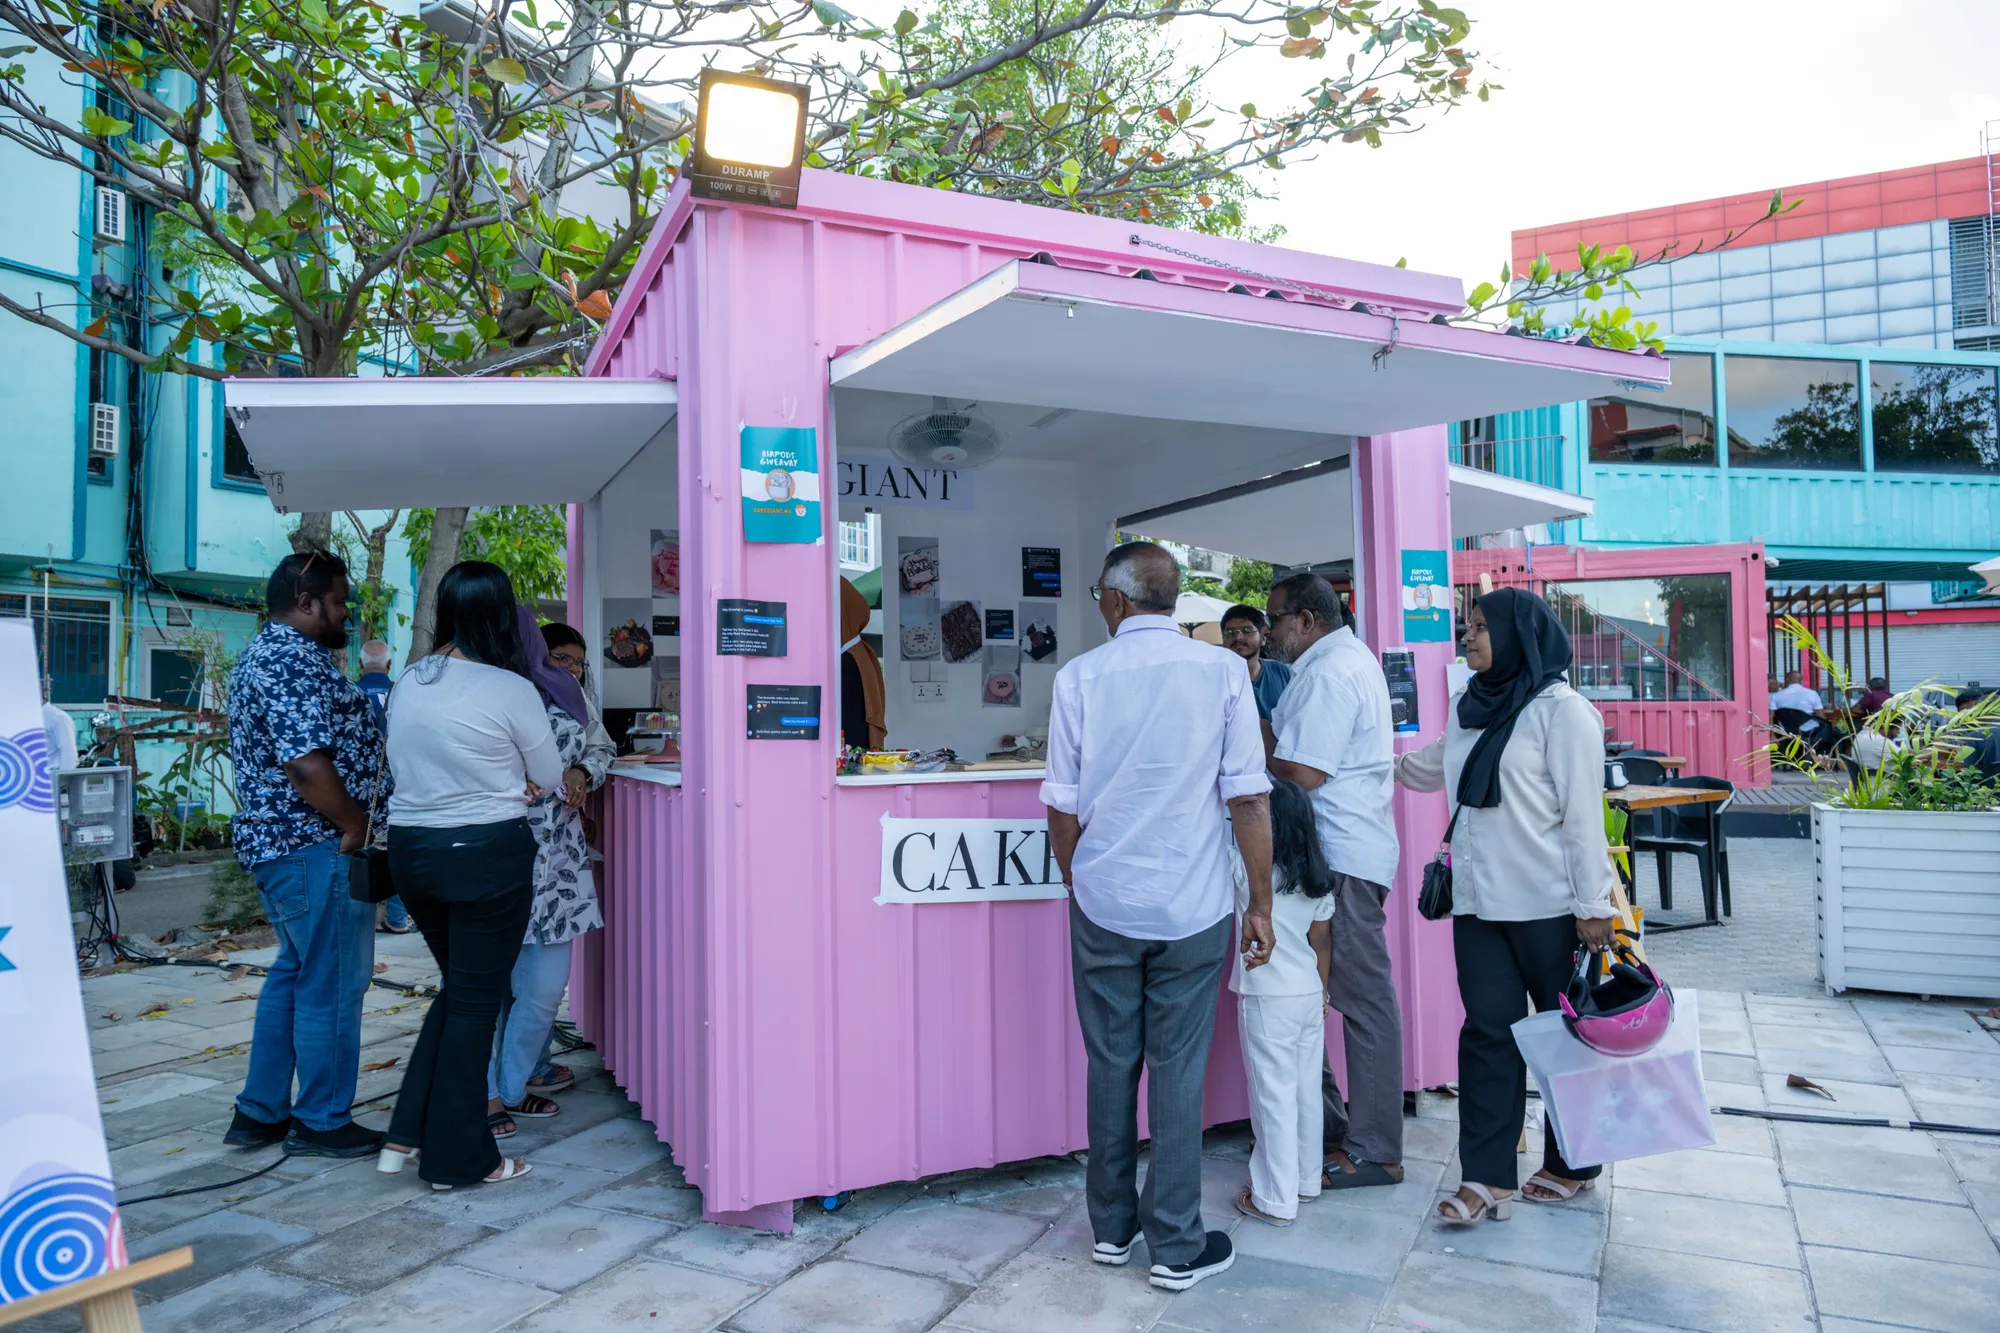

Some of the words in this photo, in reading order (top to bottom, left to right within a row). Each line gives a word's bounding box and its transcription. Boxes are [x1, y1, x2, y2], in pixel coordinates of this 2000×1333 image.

[722, 165, 770, 179] DURAMP
[710, 181, 733, 191] 100W
[761, 450, 795, 459] AIRPODS
[760, 458, 798, 467] GIVEAWAY
